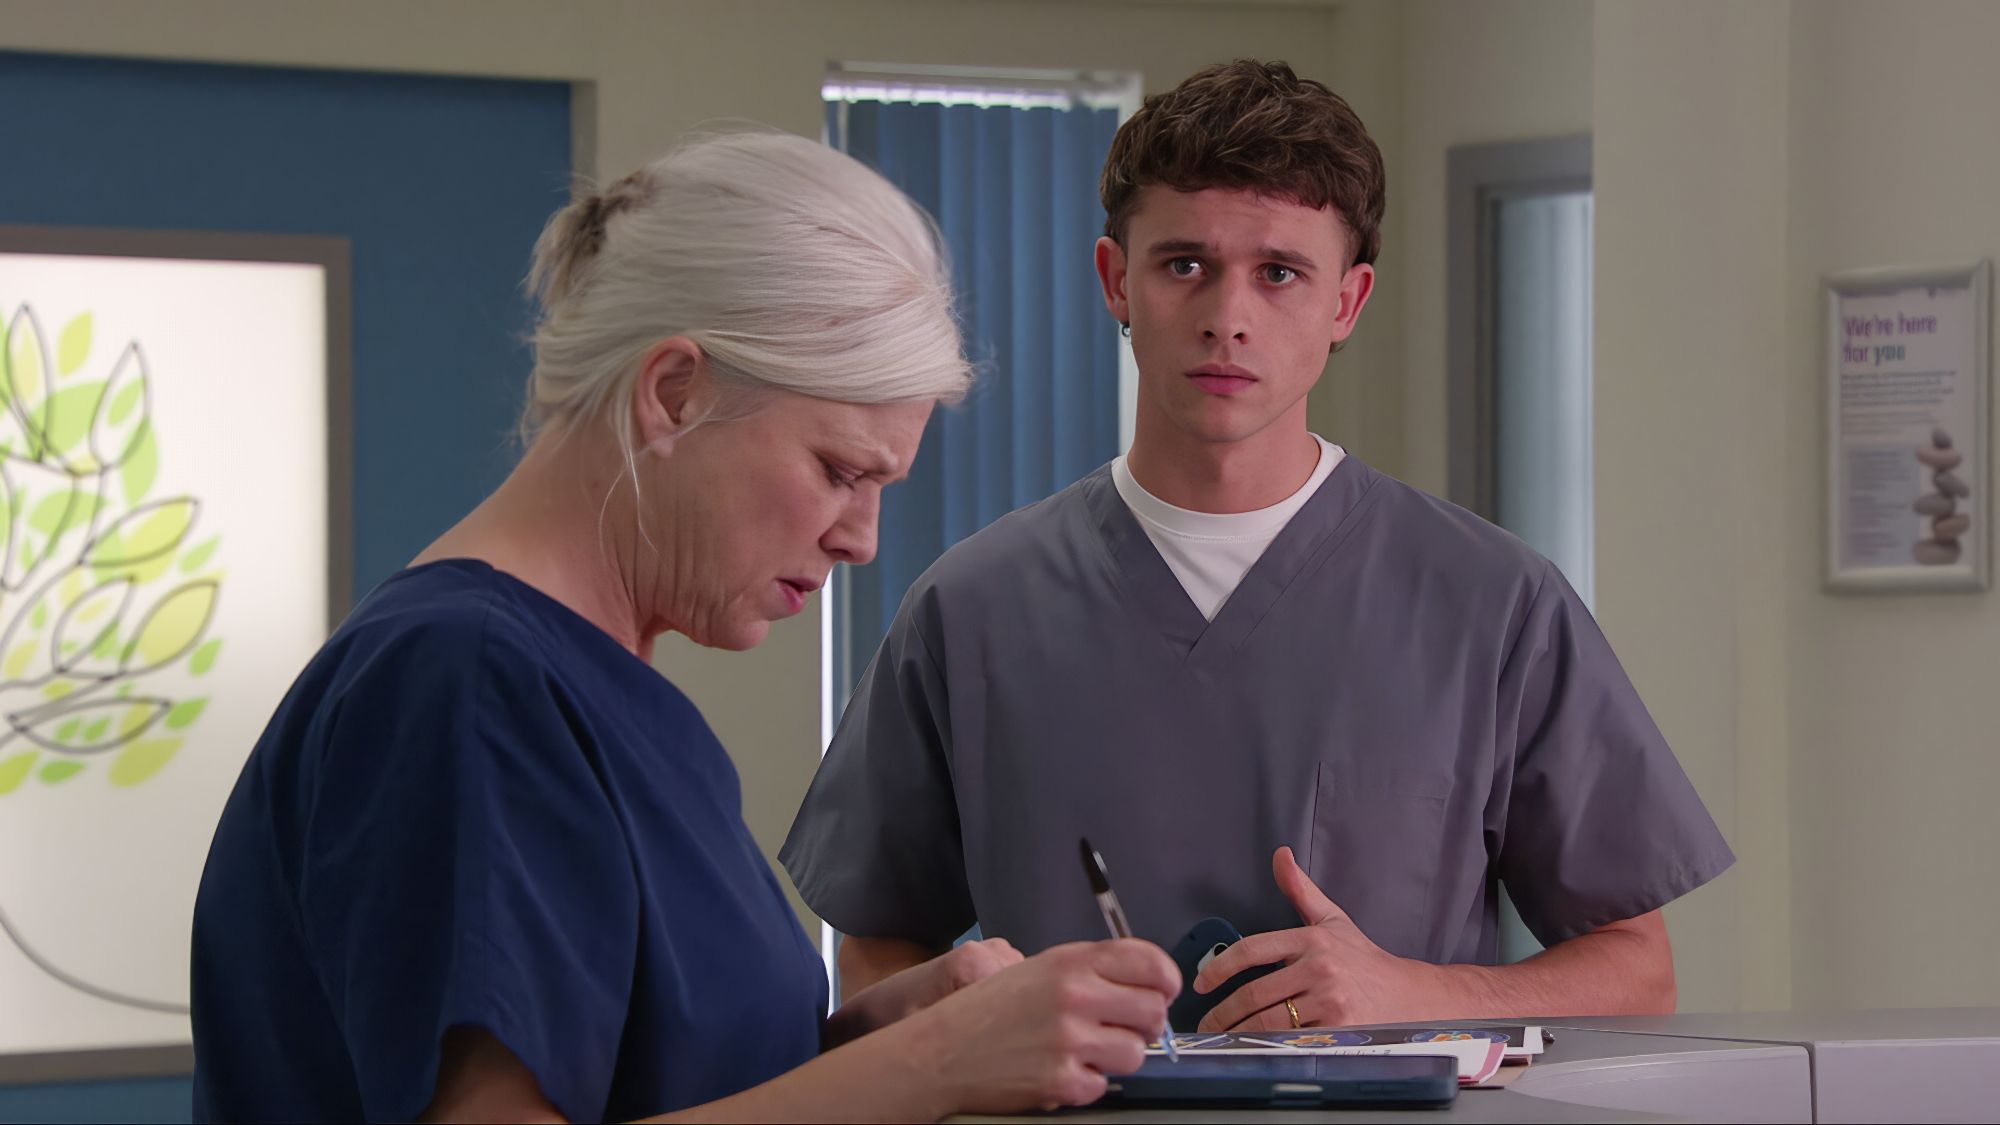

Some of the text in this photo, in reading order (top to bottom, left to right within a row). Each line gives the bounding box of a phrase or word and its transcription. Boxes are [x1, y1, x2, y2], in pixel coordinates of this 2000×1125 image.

[1843, 311, 1937, 337] We're here
[1842, 341, 1906, 366] for you
